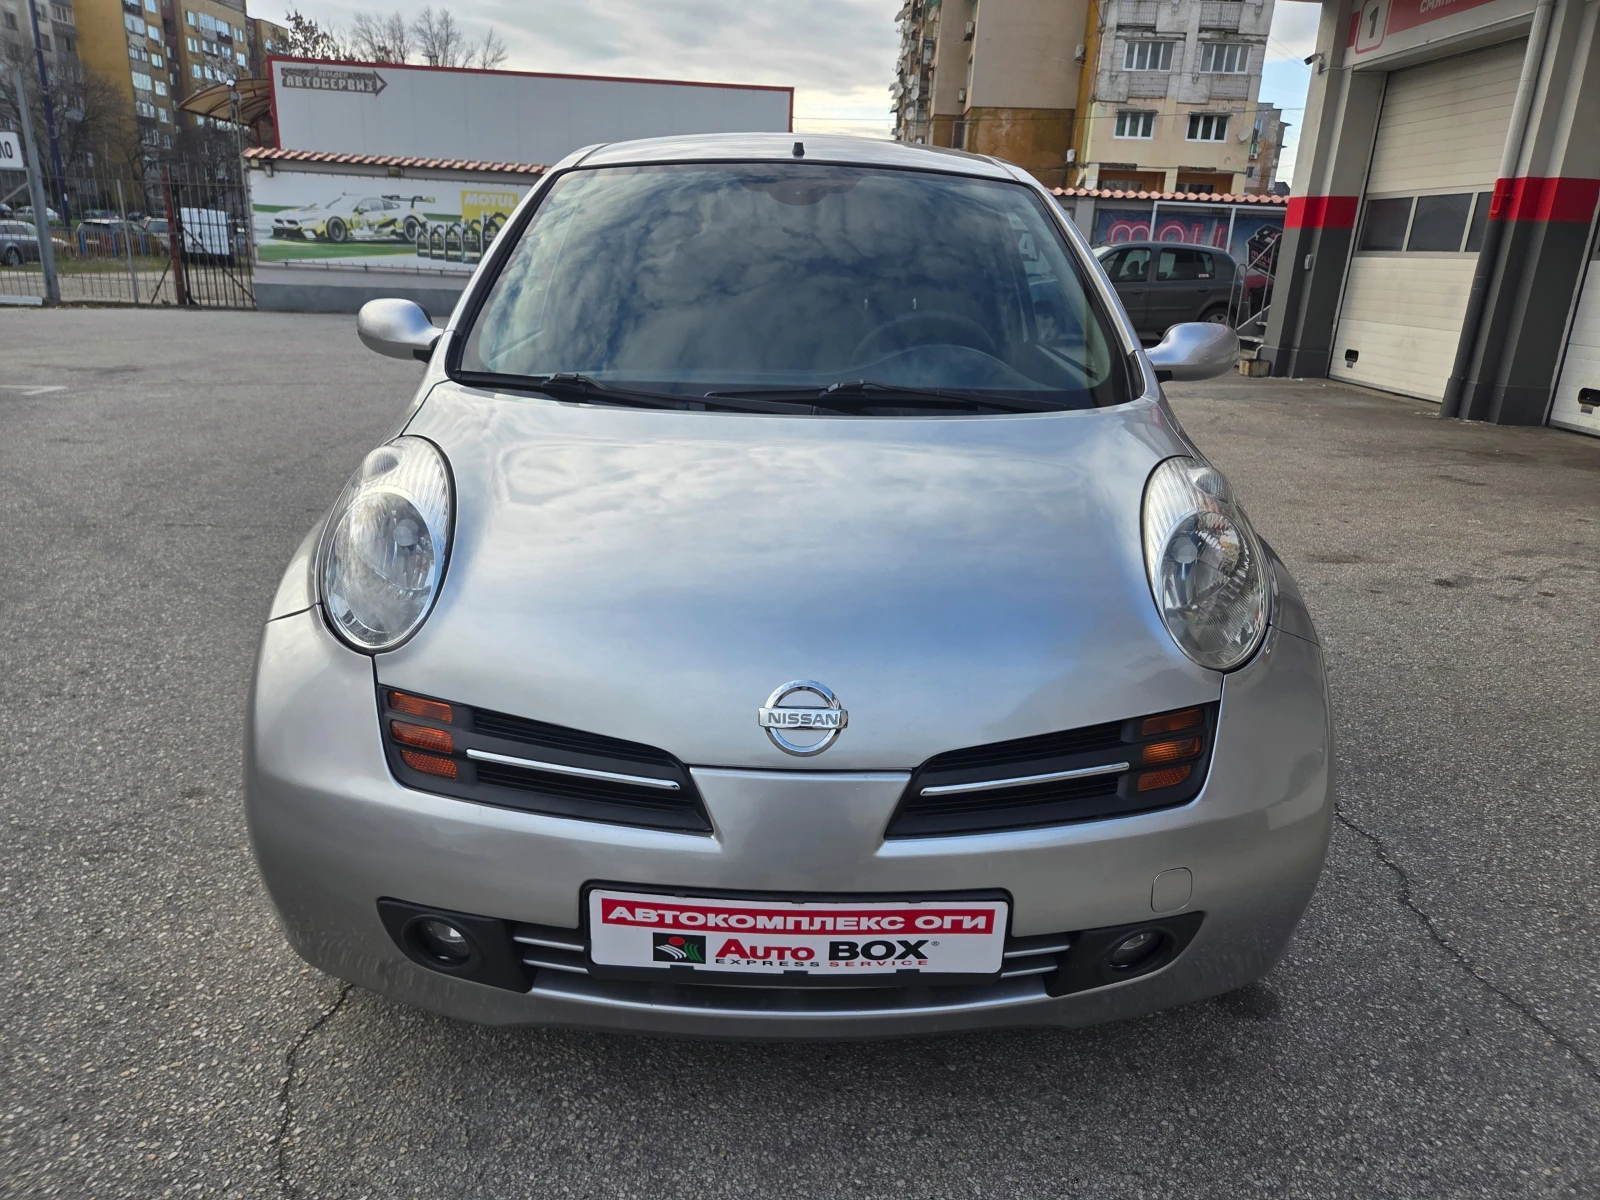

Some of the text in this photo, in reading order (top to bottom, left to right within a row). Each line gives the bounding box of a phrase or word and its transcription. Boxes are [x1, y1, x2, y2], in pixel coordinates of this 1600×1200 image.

[1369, 6, 1380, 39] 1
[286, 75, 374, 91] АВТОСЕРВИЗ
[465, 193, 515, 207] MOTUL
[768, 712, 839, 725] NISSAN
[608, 906, 987, 931] АВТОКОМПЛЕКС ОГИ
[716, 958, 820, 967] EXPRESS
